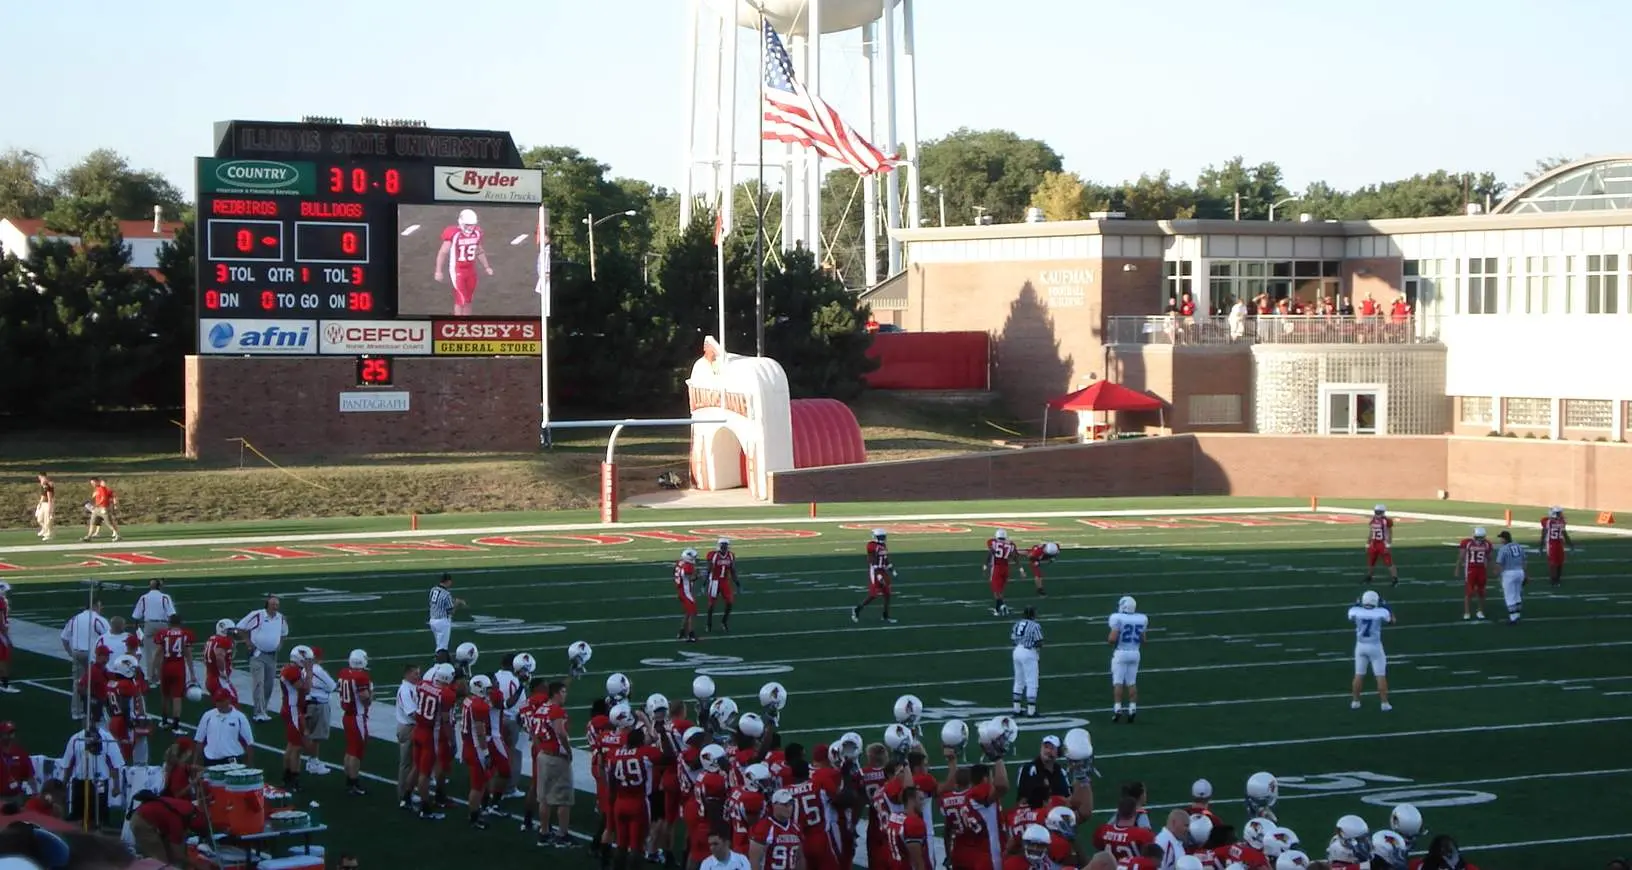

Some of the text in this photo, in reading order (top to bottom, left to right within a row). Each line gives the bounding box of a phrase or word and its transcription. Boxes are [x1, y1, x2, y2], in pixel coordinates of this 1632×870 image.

[241, 128, 503, 160] ILLINOIS STATE UNIVERSITY
[227, 166, 287, 179] COUNTRY
[463, 170, 519, 189] Ryder
[212, 201, 277, 215] REDBIRDS
[301, 203, 362, 217] BULLDOGS
[216, 263, 364, 285] 3 TOL QTR 1 TOL 3
[1039, 270, 1094, 284] KAUFMAN
[220, 293, 239, 308] DN
[277, 293, 295, 308] TO
[300, 294, 319, 309] GO
[329, 294, 346, 309] ON
[348, 293, 373, 312] 30
[239, 326, 310, 348] afni
[345, 327, 425, 342] CEFCU
[441, 324, 535, 339] CASEY'S
[441, 343, 536, 353] GENERAL STORE
[362, 358, 388, 381] 25
[342, 399, 406, 409] PANTAGRAPH
[995, 542, 1012, 558] 57
[1121, 623, 1144, 643] 25
[1361, 619, 1374, 637] 7
[163, 636, 183, 659] 14
[416, 691, 437, 720] 10
[614, 758, 643, 787] 49
